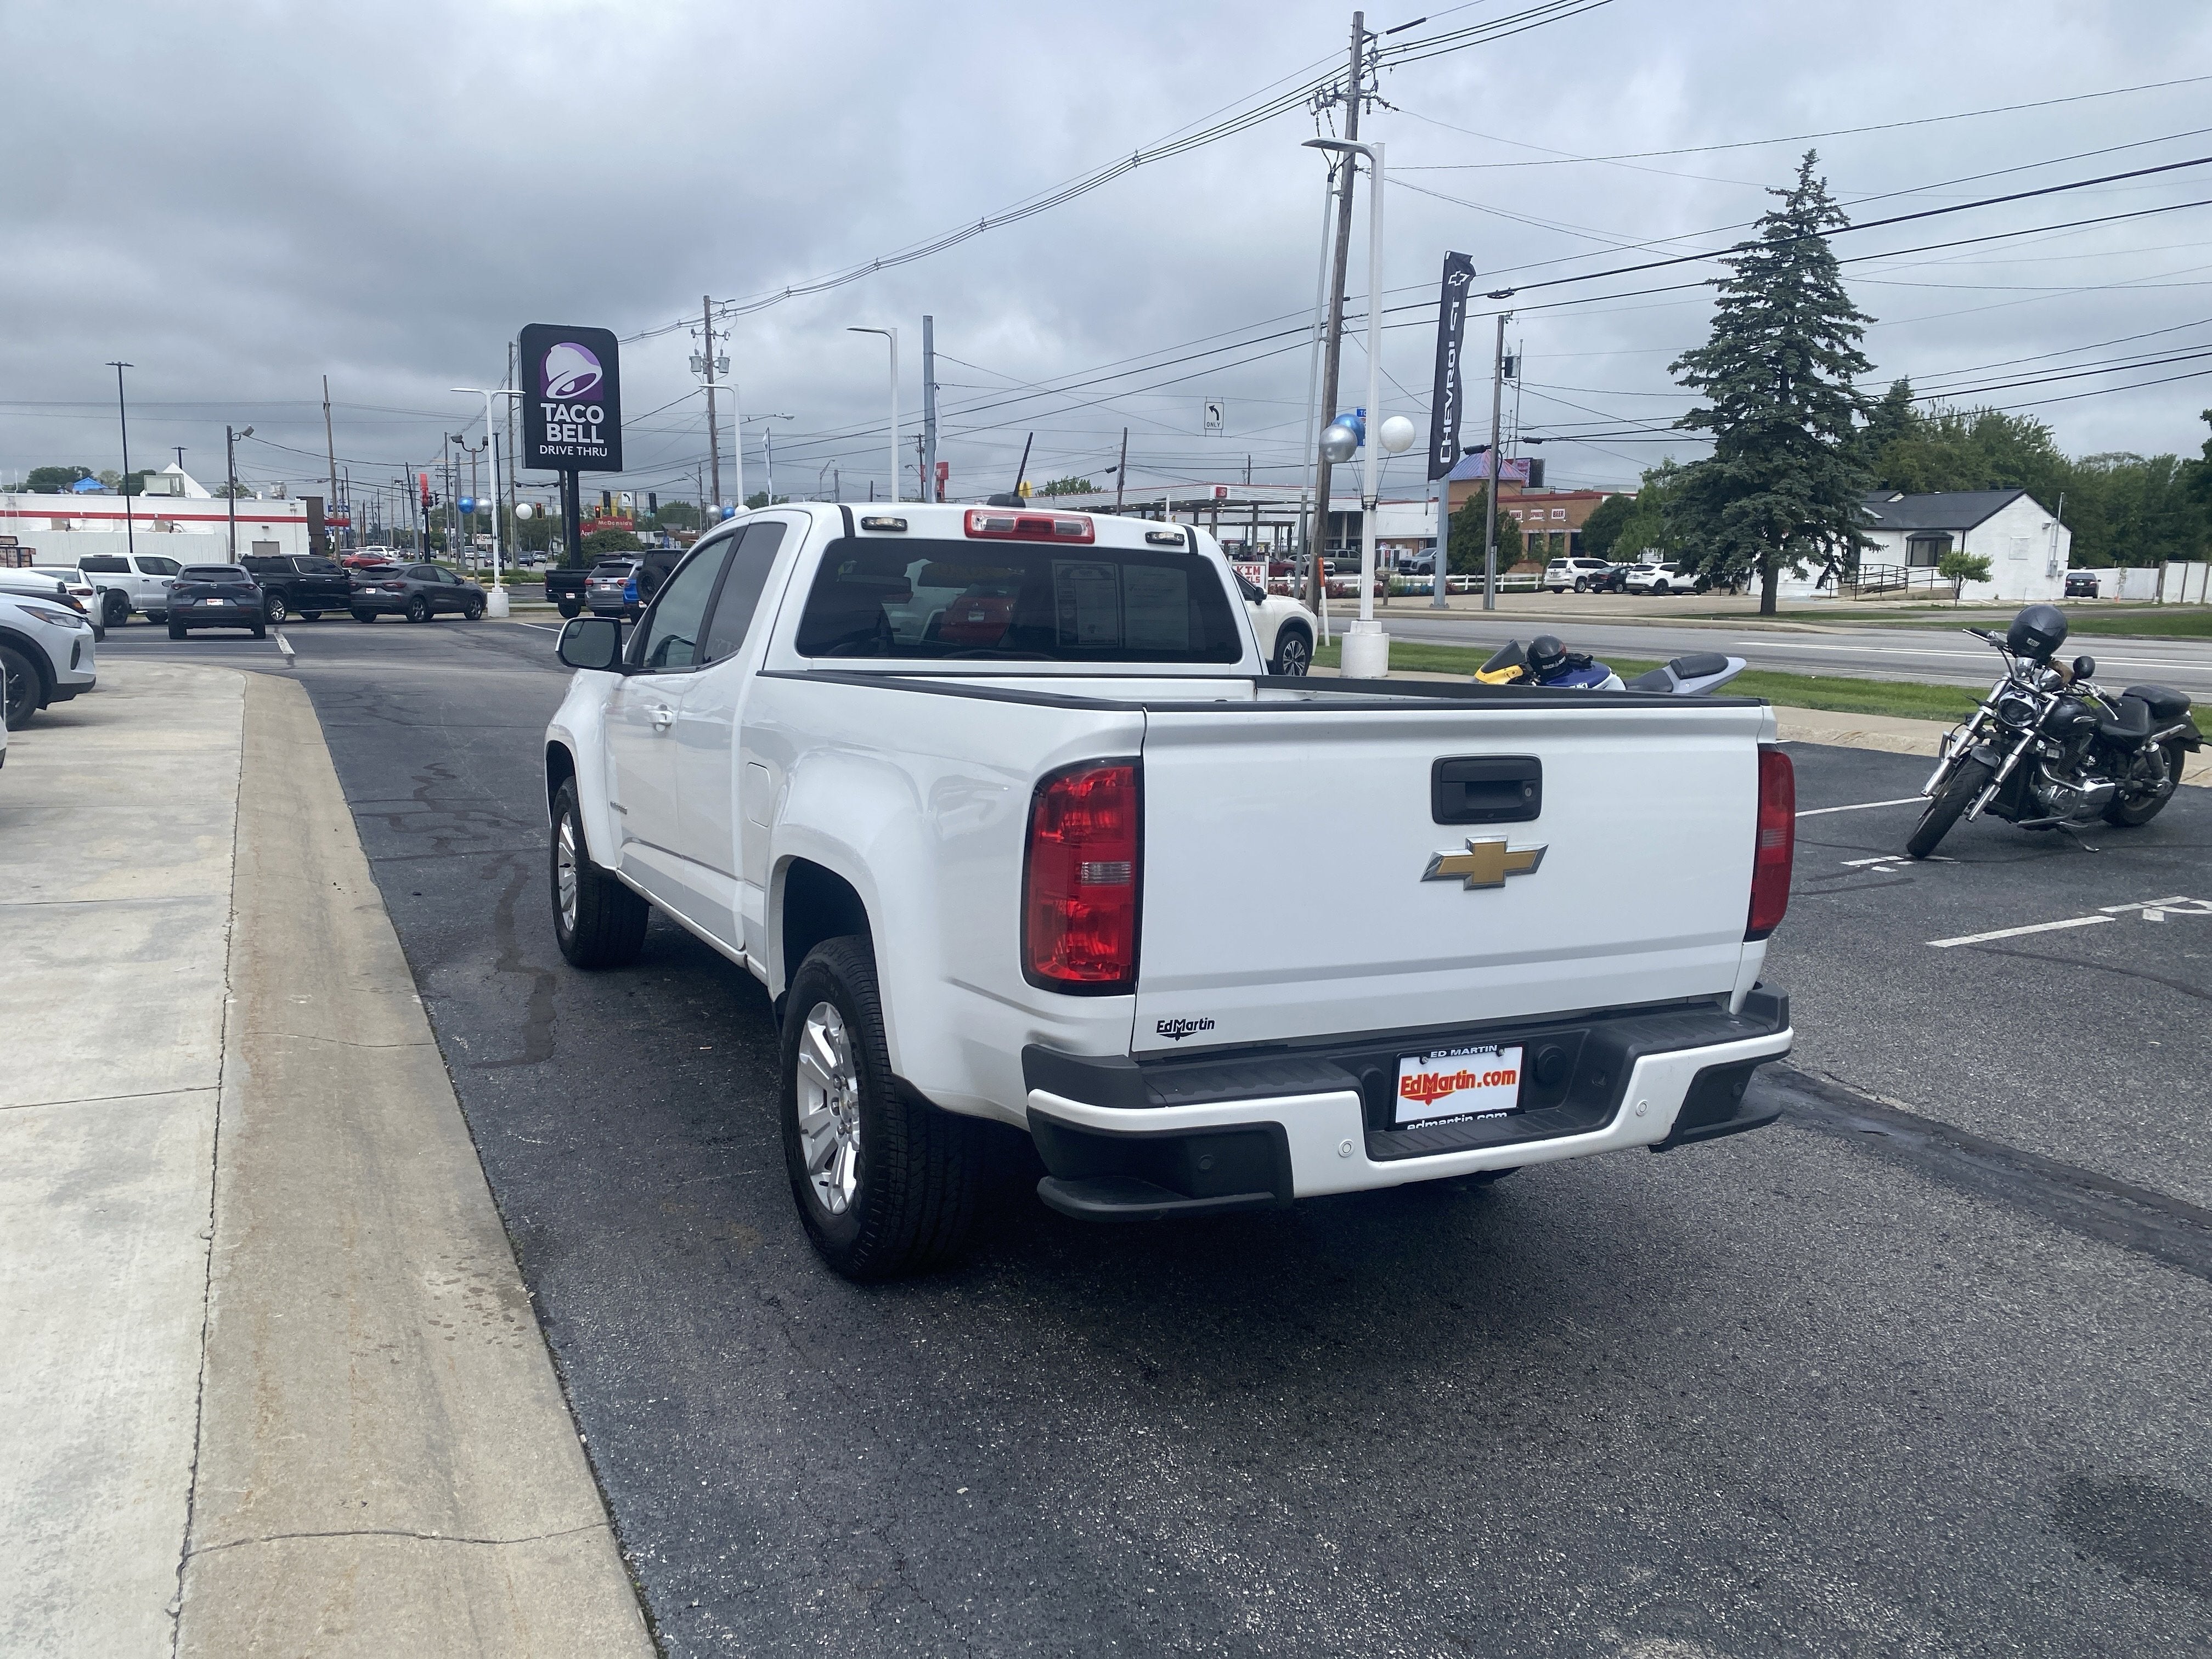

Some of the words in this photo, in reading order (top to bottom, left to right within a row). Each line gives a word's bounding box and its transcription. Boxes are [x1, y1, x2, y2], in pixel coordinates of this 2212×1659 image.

[540, 403, 604, 424] TACO
[546, 423, 604, 443] BELL
[539, 445, 574, 455] DRIVE
[576, 446, 607, 456] THRU
[1237, 566, 1261, 575] KIM
[1430, 1050, 1447, 1058] ED
[1450, 1045, 1498, 1056] MARTIN
[1400, 1069, 1516, 1099] EdMartin.com
